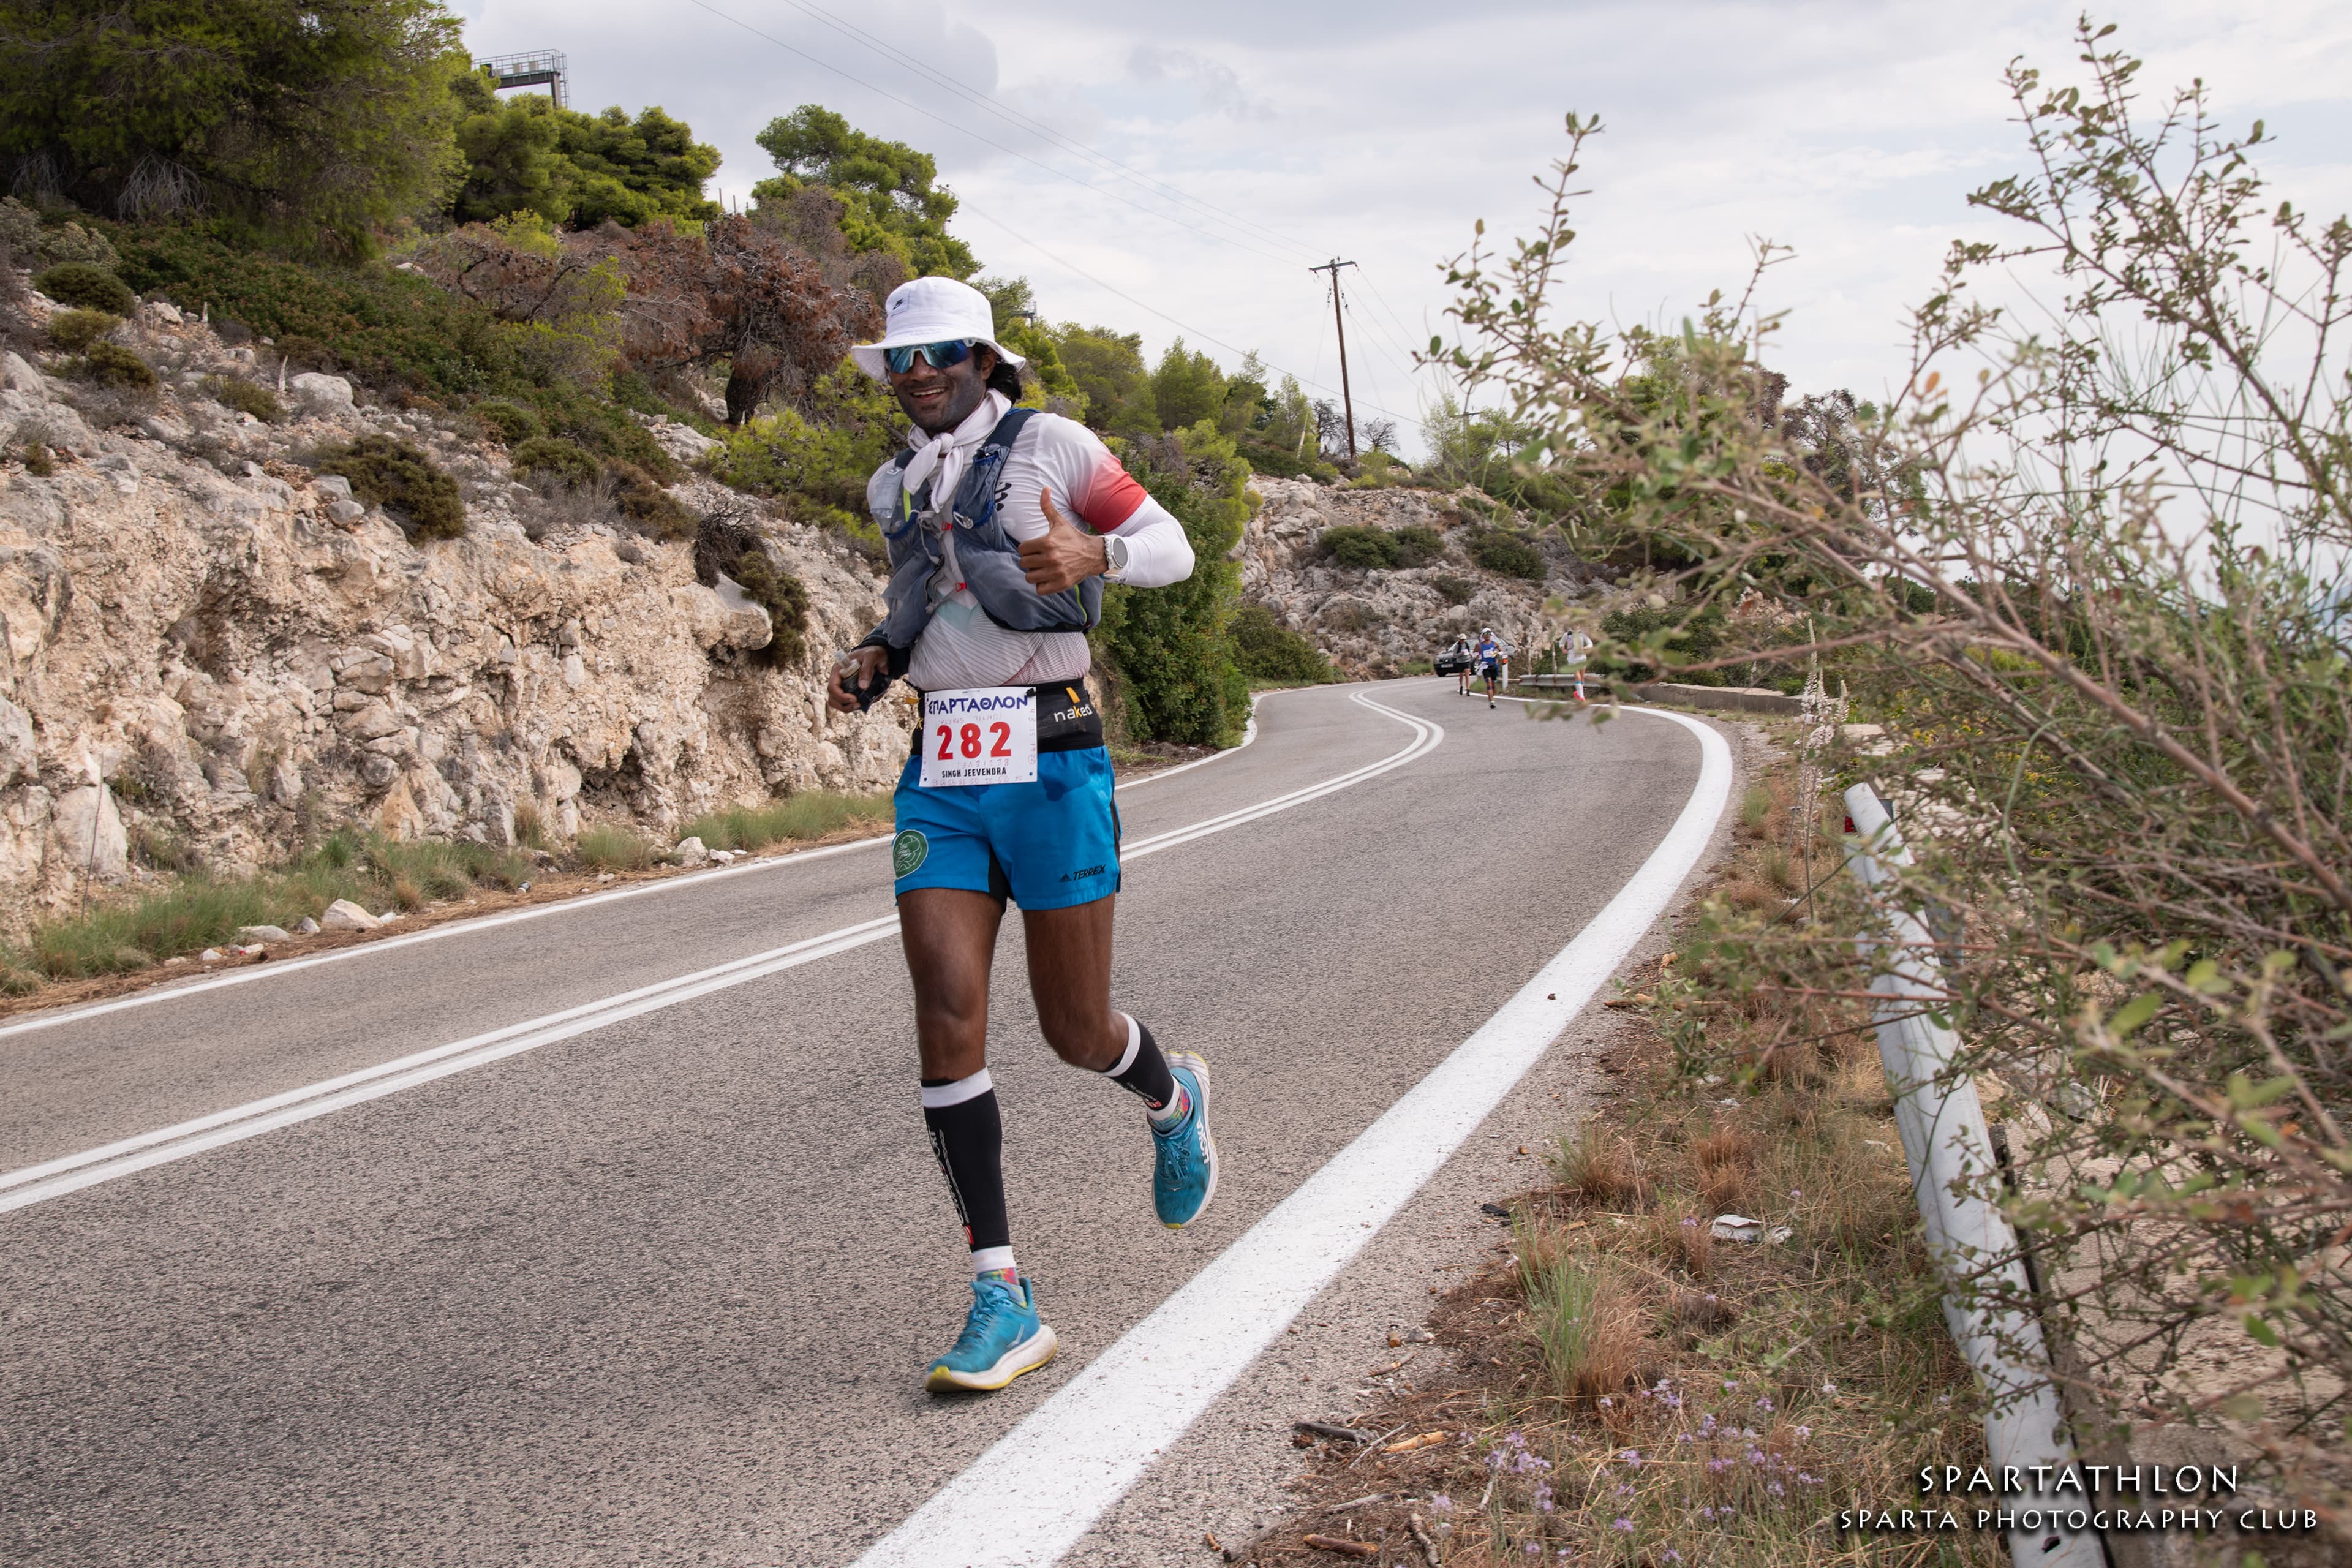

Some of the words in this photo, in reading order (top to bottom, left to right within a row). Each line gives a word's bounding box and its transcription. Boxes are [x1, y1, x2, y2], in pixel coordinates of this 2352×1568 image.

[1054, 704, 1093, 722] naked
[937, 721, 1012, 761] 282
[941, 769, 961, 778] SINGH
[964, 767, 1007, 777] JEEVENDRA
[1073, 864, 1106, 881] TERREX
